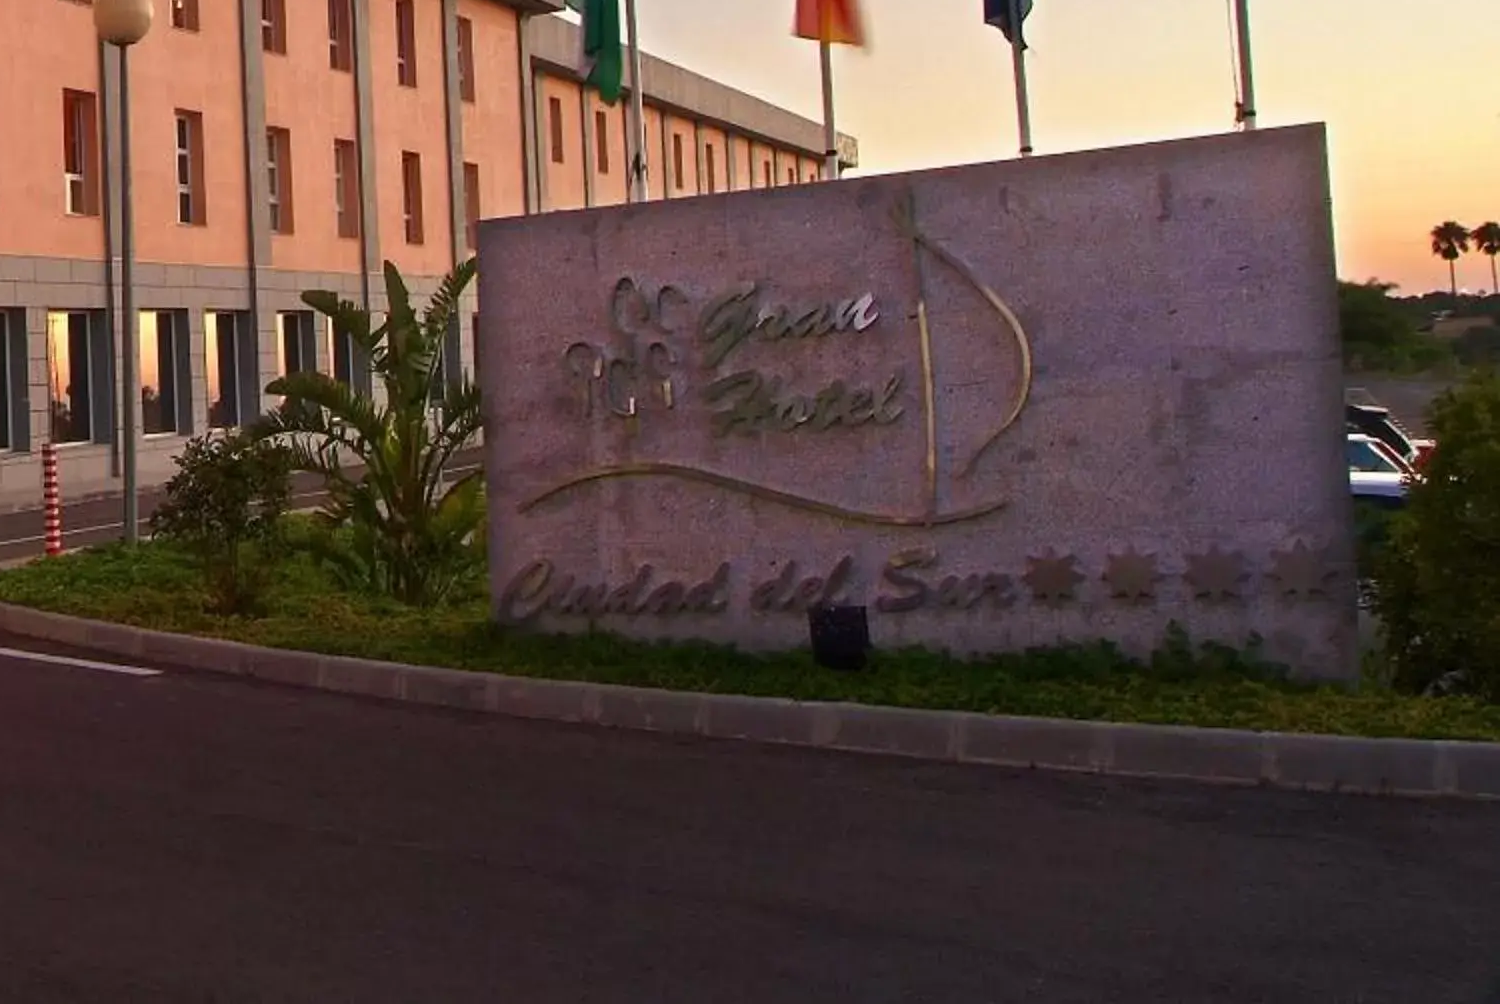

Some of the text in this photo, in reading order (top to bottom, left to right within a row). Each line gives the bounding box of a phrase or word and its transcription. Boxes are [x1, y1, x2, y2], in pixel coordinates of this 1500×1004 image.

[700, 281, 880, 369] Gran
[701, 369, 905, 438] Hotel
[500, 545, 1013, 620] Ciudad del Sur
